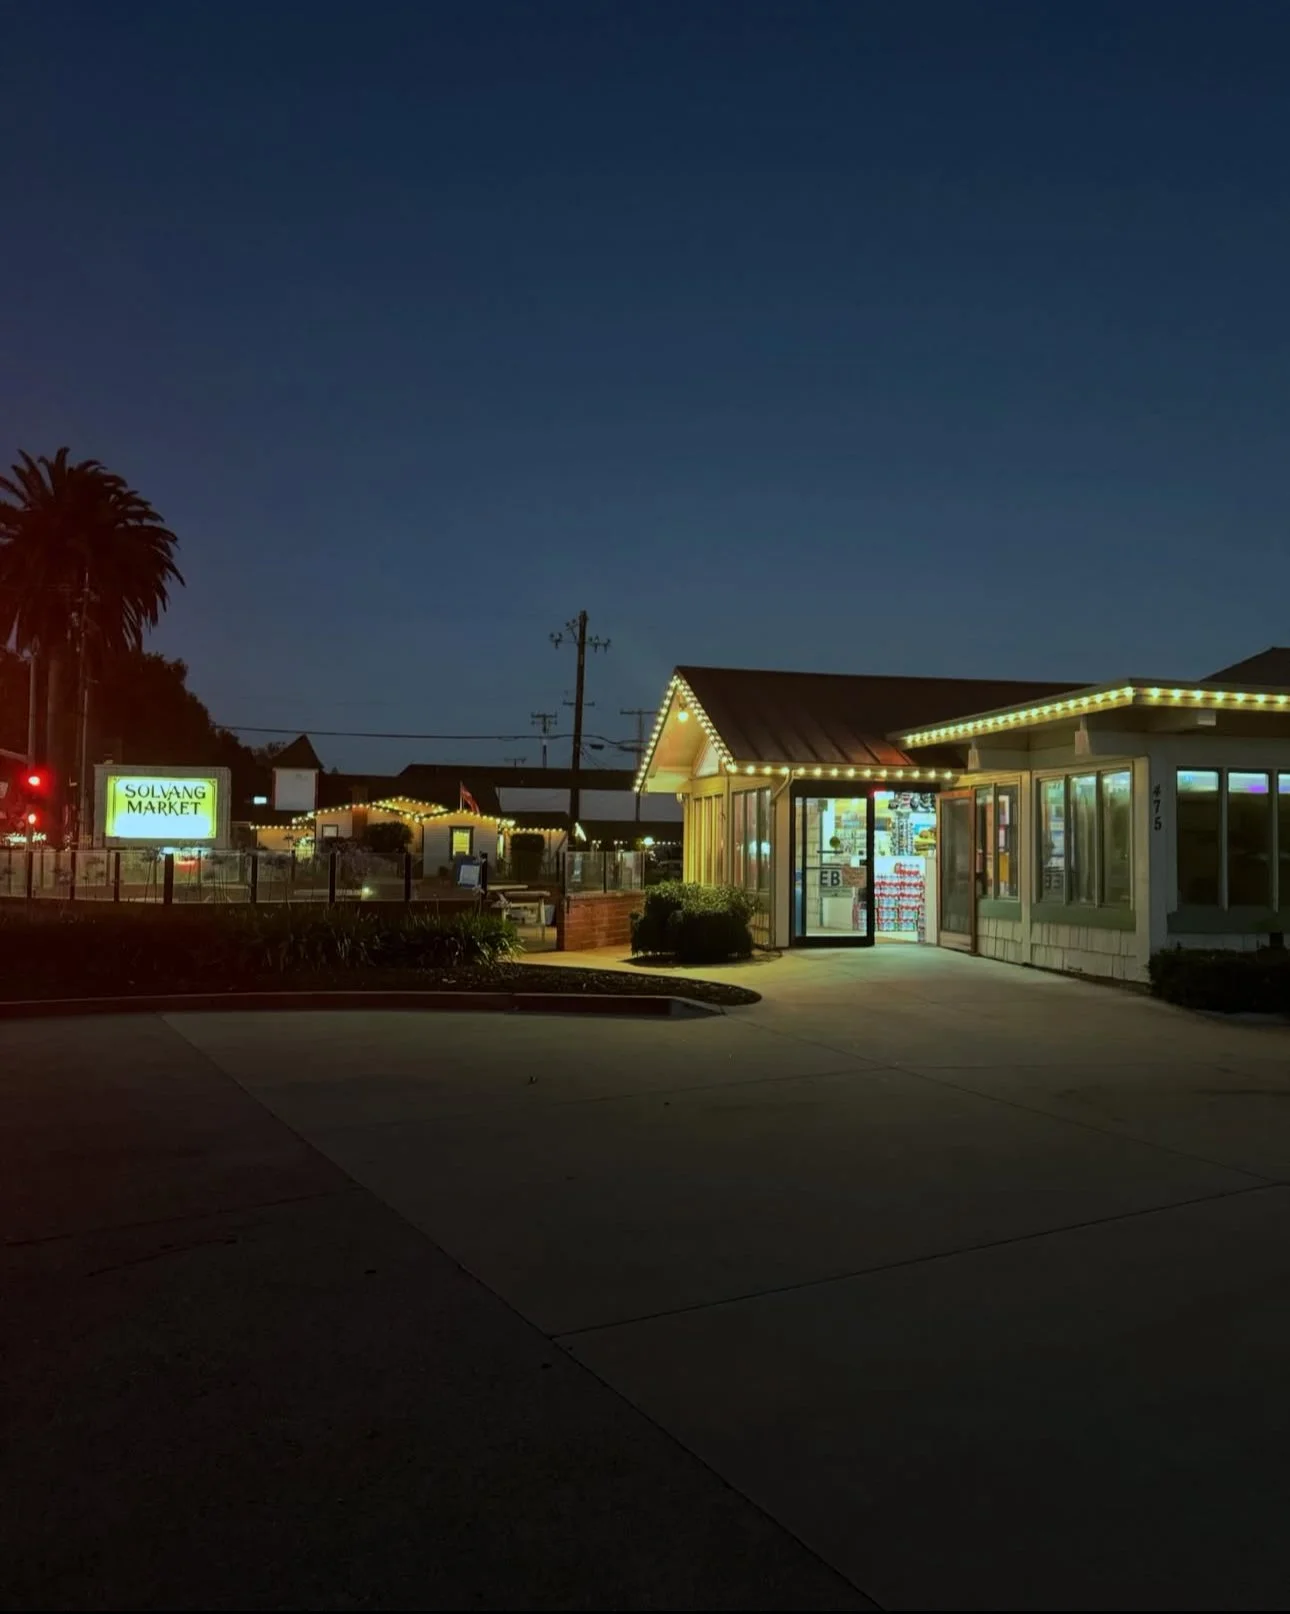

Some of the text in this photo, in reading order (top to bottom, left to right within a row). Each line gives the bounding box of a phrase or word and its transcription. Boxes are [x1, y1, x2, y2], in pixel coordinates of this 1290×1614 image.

[125, 783, 206, 800] SOLVANG
[127, 800, 201, 816] MARKET
[1153, 784, 1162, 831] 475
